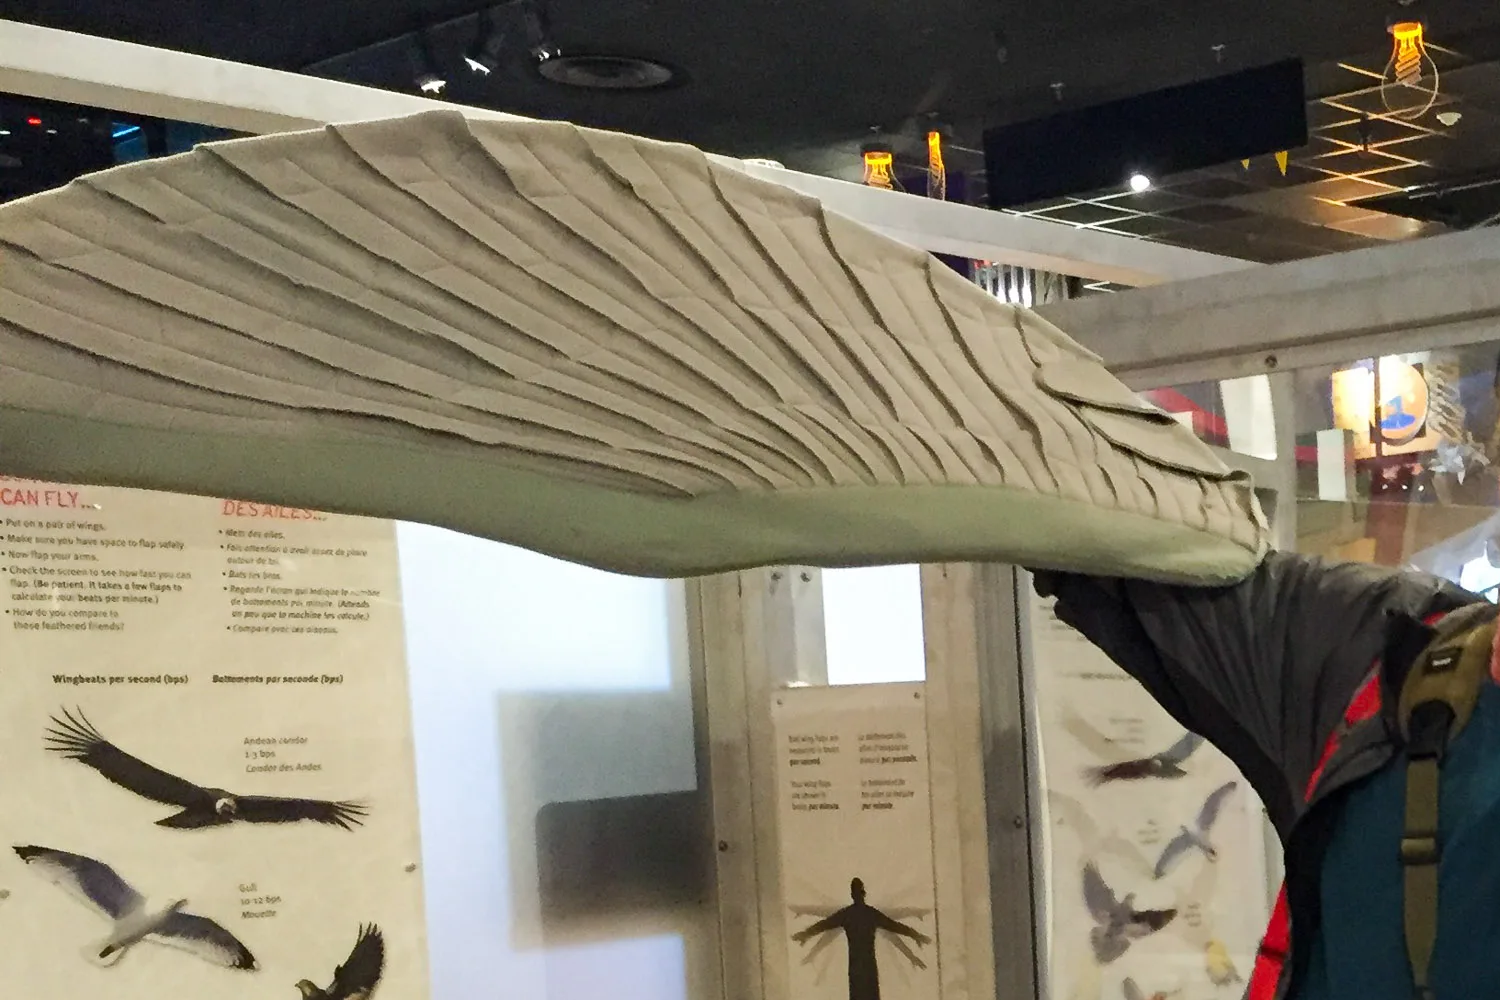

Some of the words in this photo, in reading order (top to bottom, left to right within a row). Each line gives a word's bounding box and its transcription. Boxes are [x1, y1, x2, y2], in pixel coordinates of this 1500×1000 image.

[0, 488, 39, 507] CAN
[223, 500, 258, 517] DES
[6, 518, 21, 528] Put
[66, 519, 76, 529] of
[7, 534, 32, 544] Make
[58, 538, 74, 547] you
[77, 536, 98, 546] have
[100, 539, 126, 549] space
[128, 539, 137, 548] to
[139, 538, 156, 550] flap
[8, 550, 29, 559] Now
[51, 552, 71, 562] your
[9, 566, 37, 576] Check
[40, 567, 55, 577] the
[57, 569, 87, 577] screen
[90, 569, 99, 577] to
[119, 568, 138, 578] how
[159, 572, 175, 581] you
[176, 572, 192, 580] can
[33, 579, 49, 588] (Be
[98, 579, 123, 590] takes
[173, 583, 183, 592] to
[78, 592, 103, 602] beats
[105, 595, 120, 605] per
[12, 607, 34, 617] How
[35, 607, 47, 617] do
[49, 609, 66, 620] you
[68, 610, 107, 620] compare
[52, 674, 106, 686] Wingbeats
[109, 676, 125, 686] per
[128, 674, 162, 684] second
[164, 673, 189, 685] (bps)
[320, 673, 344, 685] (bps)
[260, 749, 276, 759] bps
